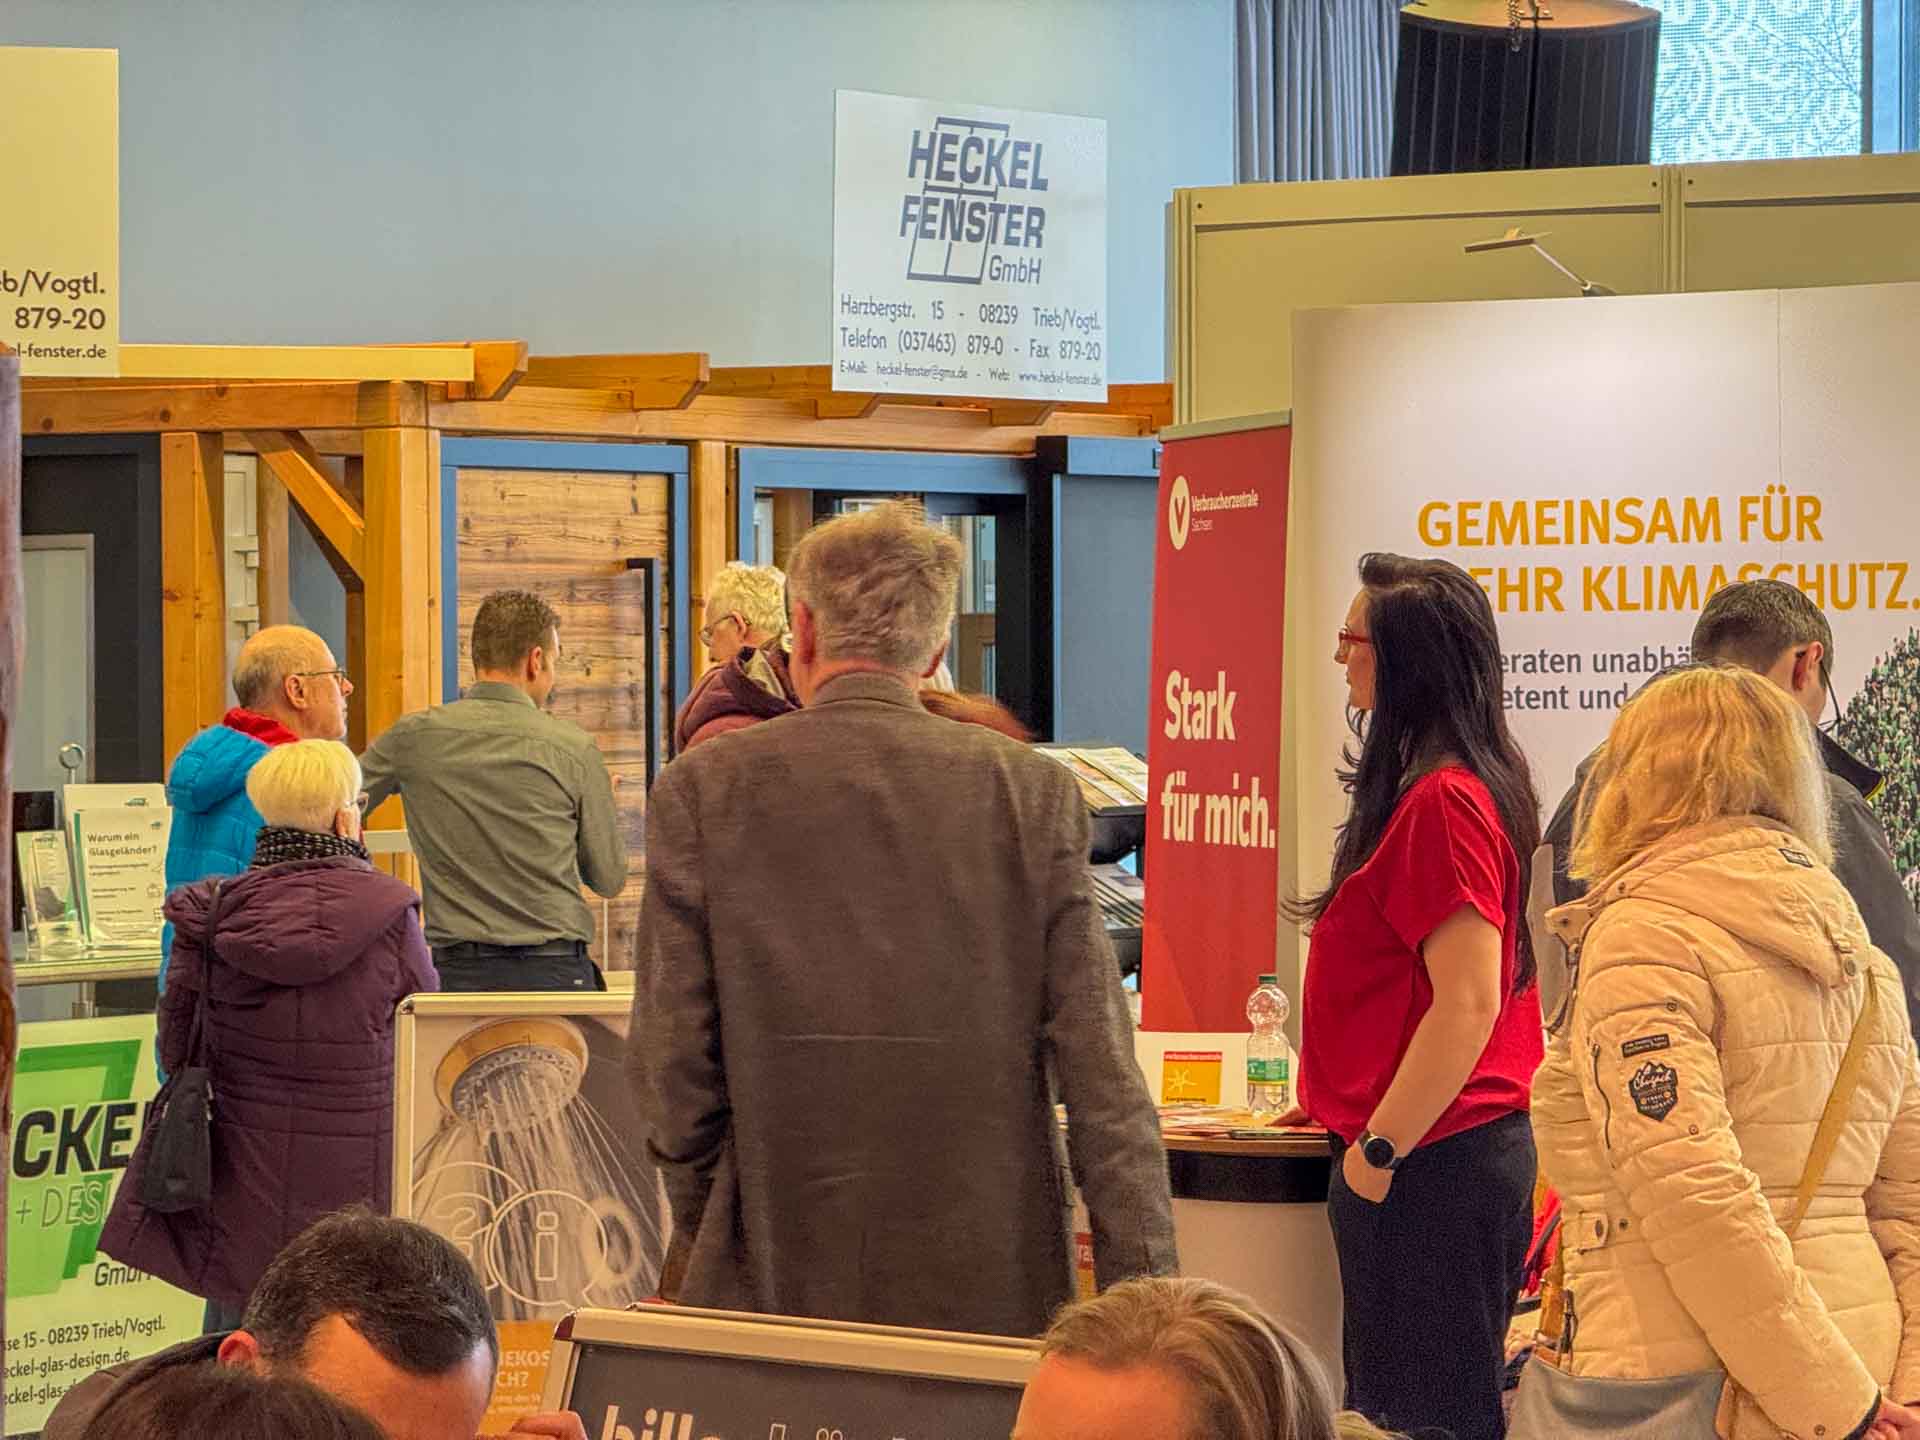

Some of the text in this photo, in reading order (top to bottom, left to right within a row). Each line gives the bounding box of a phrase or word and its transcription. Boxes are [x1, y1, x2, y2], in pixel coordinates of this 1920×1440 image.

[908, 129, 1049, 192] HECKEL
[899, 194, 1046, 249] FENSTER
[0, 269, 106, 301] b/Vogtl.
[988, 254, 1042, 285] GmbH
[15, 306, 107, 330] 879-20
[840, 293, 916, 323] Harzbergstr.
[931, 300, 945, 321] 15
[978, 303, 1019, 325] 08239
[1033, 306, 1102, 335] Trieb/Vogtl.
[840, 326, 888, 349] Telefon
[898, 328, 957, 357] (037463)
[967, 334, 1004, 357] 879-0
[1029, 338, 1050, 359] Fax
[1059, 340, 1101, 362] 879-20
[1191, 488, 1260, 513] Verbraucherzentrale
[1417, 483, 1824, 548] GEMEINSAM FÜR
[1467, 561, 1920, 614] EHR KLIMAHUTZ.
[1500, 645, 1692, 675] eraten unabhä
[1163, 669, 1237, 742] Stark
[1501, 685, 1569, 711] etent
[1160, 770, 1276, 850] für mich.
[87, 831, 140, 844] Warum ein
[88, 845, 158, 859] Glasgeländer?
[13, 1101, 153, 1178] CKE
[41, 1181, 113, 1229] DESI
[23, 1331, 37, 1350] 15
[47, 1324, 90, 1346] 08239
[92, 1313, 166, 1340] Trieb/Vogtl.
